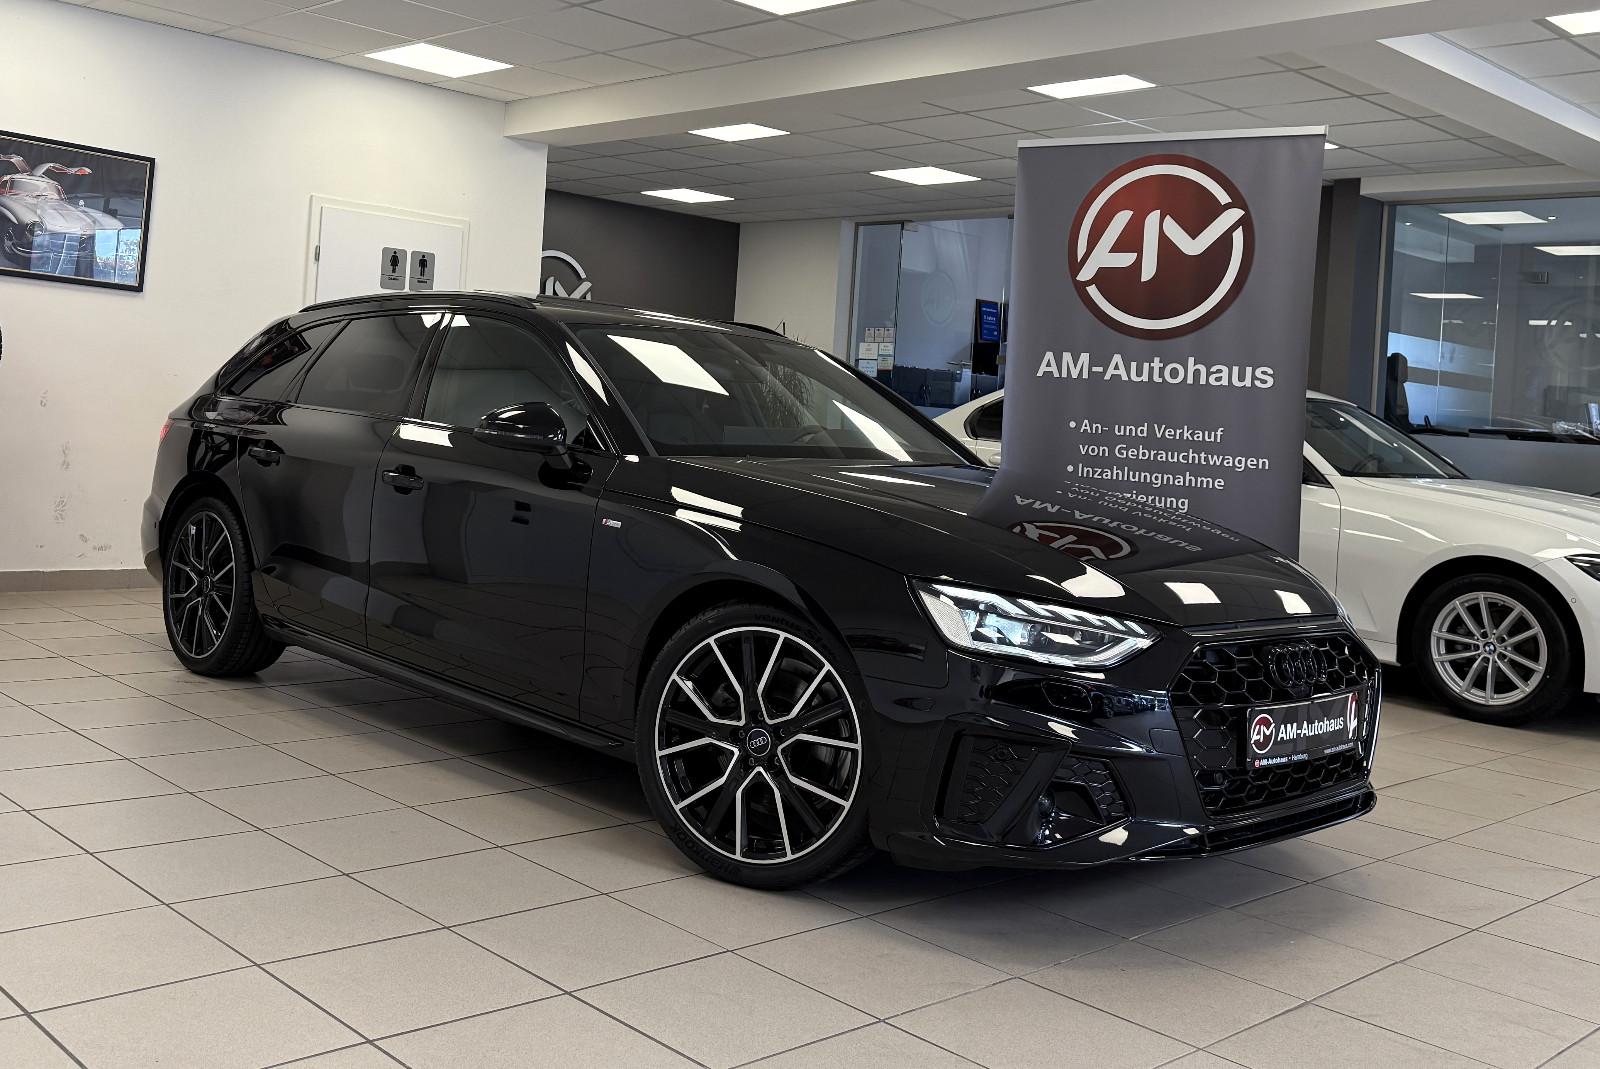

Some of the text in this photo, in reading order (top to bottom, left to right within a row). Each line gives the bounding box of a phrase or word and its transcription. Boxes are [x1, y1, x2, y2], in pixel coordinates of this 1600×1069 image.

[1076, 206, 1246, 282] AM
[1036, 350, 1275, 389] AM-Autohaus
[1080, 418, 1224, 443] An- und Verkauf
[1079, 443, 1269, 471] von Gebrauchtwagen
[1078, 463, 1225, 490] Inzahlungnahme
[1277, 715, 1344, 742] AM-Autohaus
